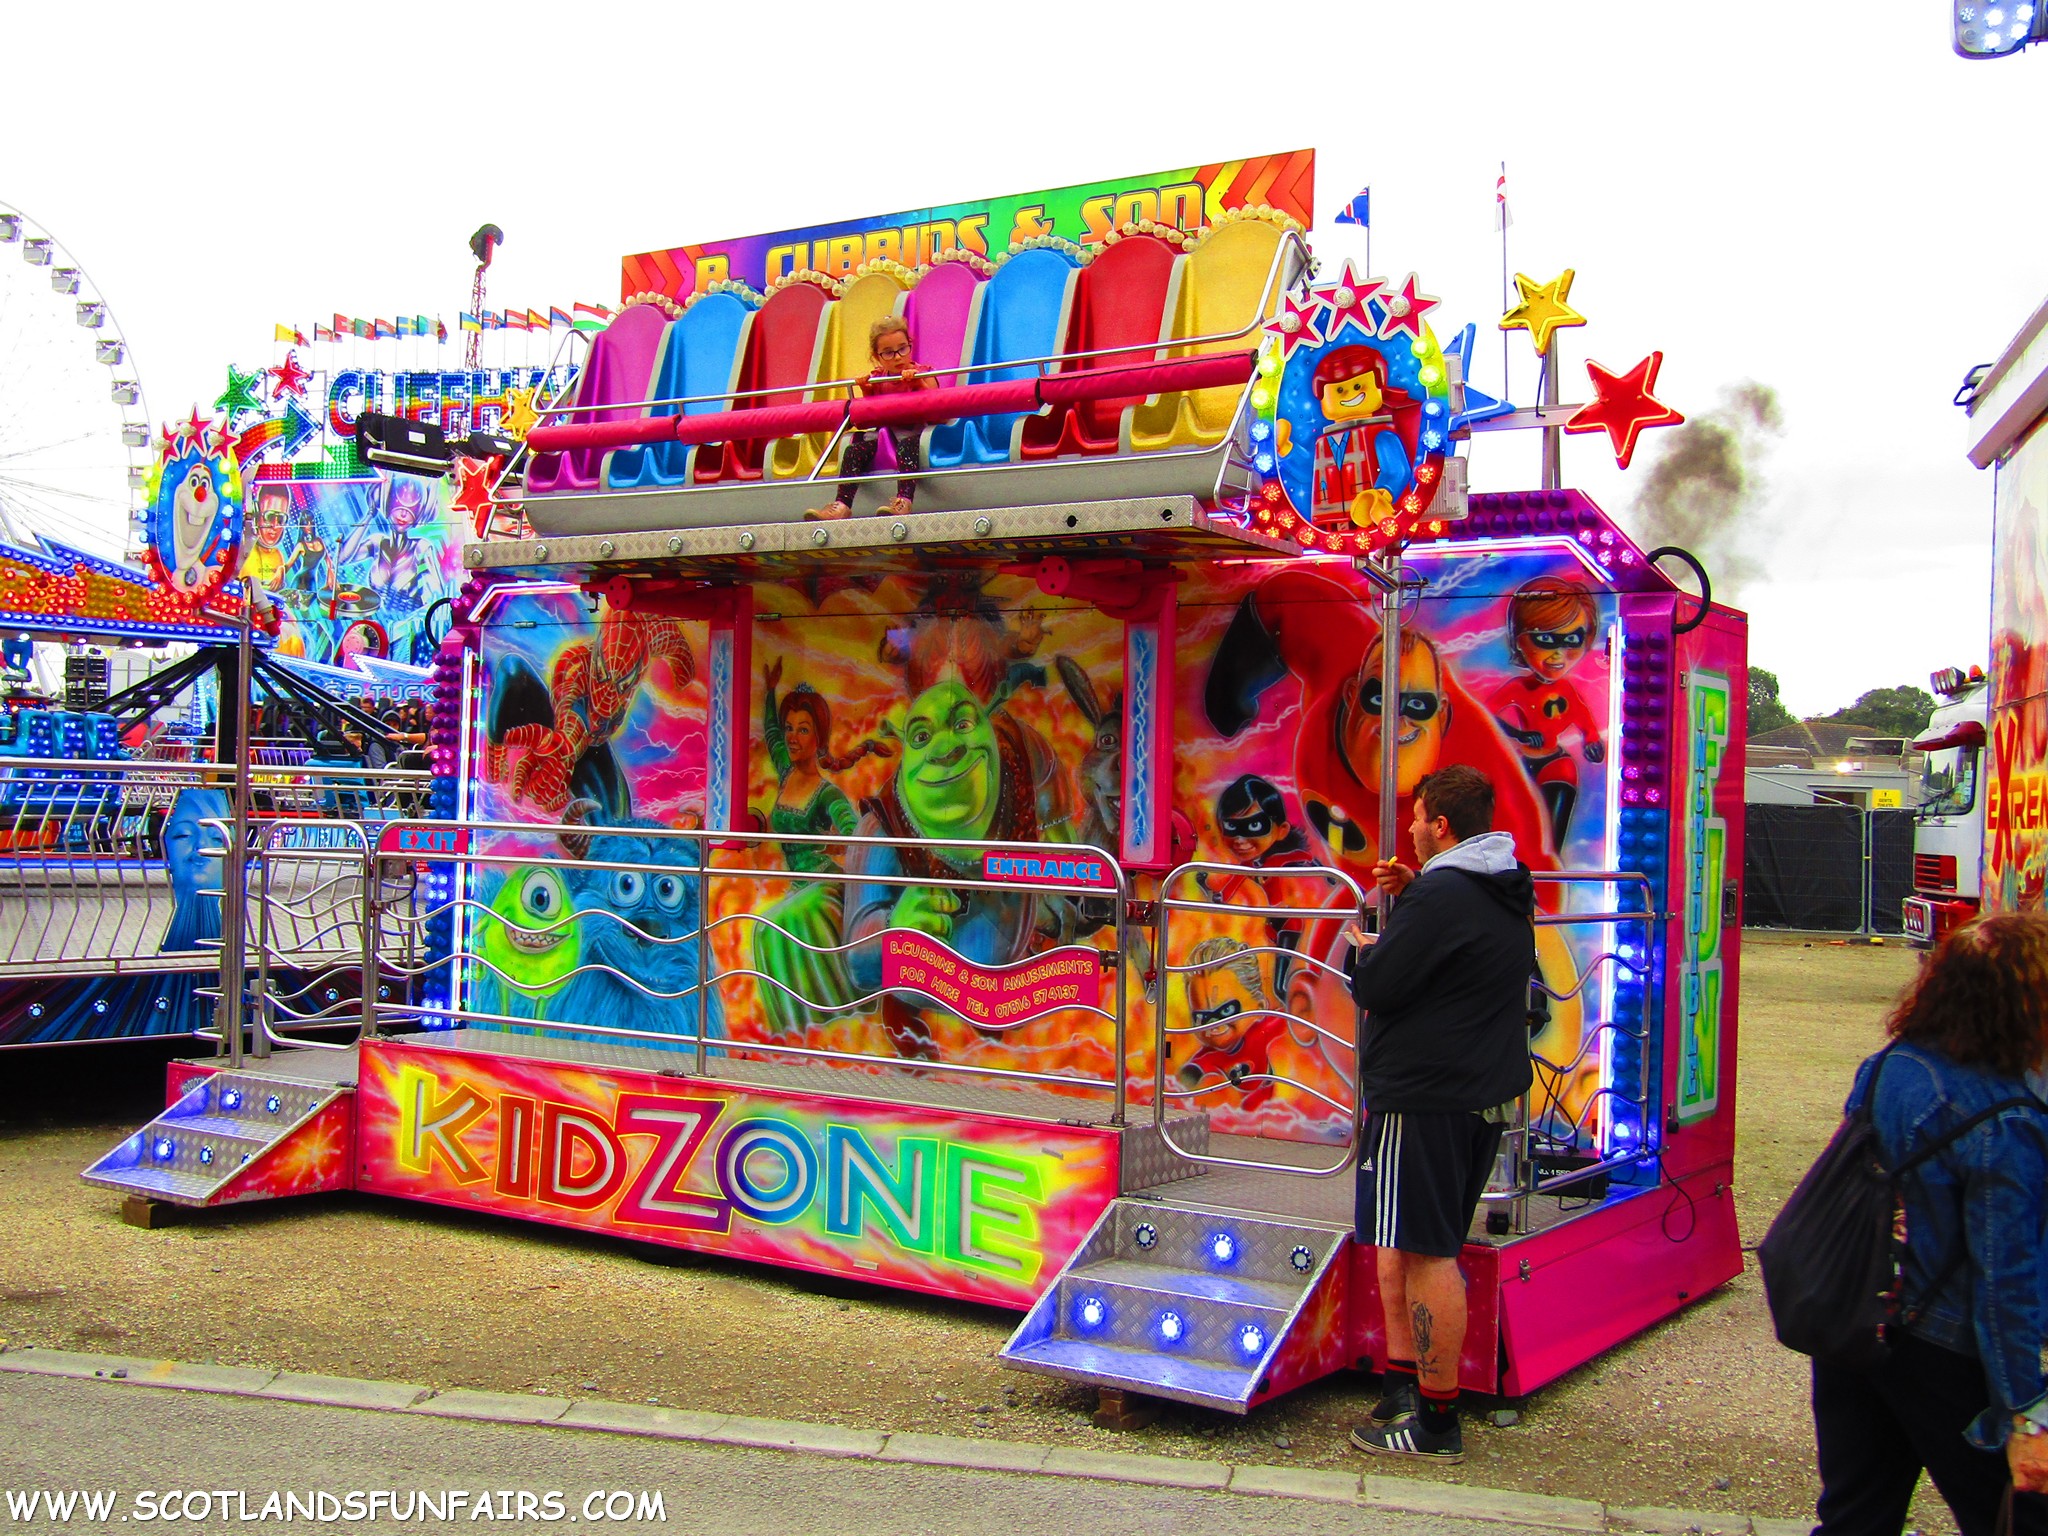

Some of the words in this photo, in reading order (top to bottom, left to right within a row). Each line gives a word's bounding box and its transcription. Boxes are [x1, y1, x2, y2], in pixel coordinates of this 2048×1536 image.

[764, 211, 990, 289] CUBBINS
[1009, 204, 1055, 244] &
[1078, 180, 1205, 248] SON
[400, 829, 458, 851] EXIT
[986, 856, 1102, 880] ENTRANCE
[1678, 670, 1731, 1121] FUN
[899, 965, 926, 984] FOR
[930, 976, 961, 1003] HIRE
[966, 997, 990, 1018] TEL:
[995, 996, 1031, 1019] 07816
[1033, 984, 1080, 1005] 574137
[957, 969, 969, 984] &
[970, 973, 998, 992] SON
[1002, 960, 1094, 992] AMUSEMENTS
[399, 1064, 1048, 1285] KIDZONE
